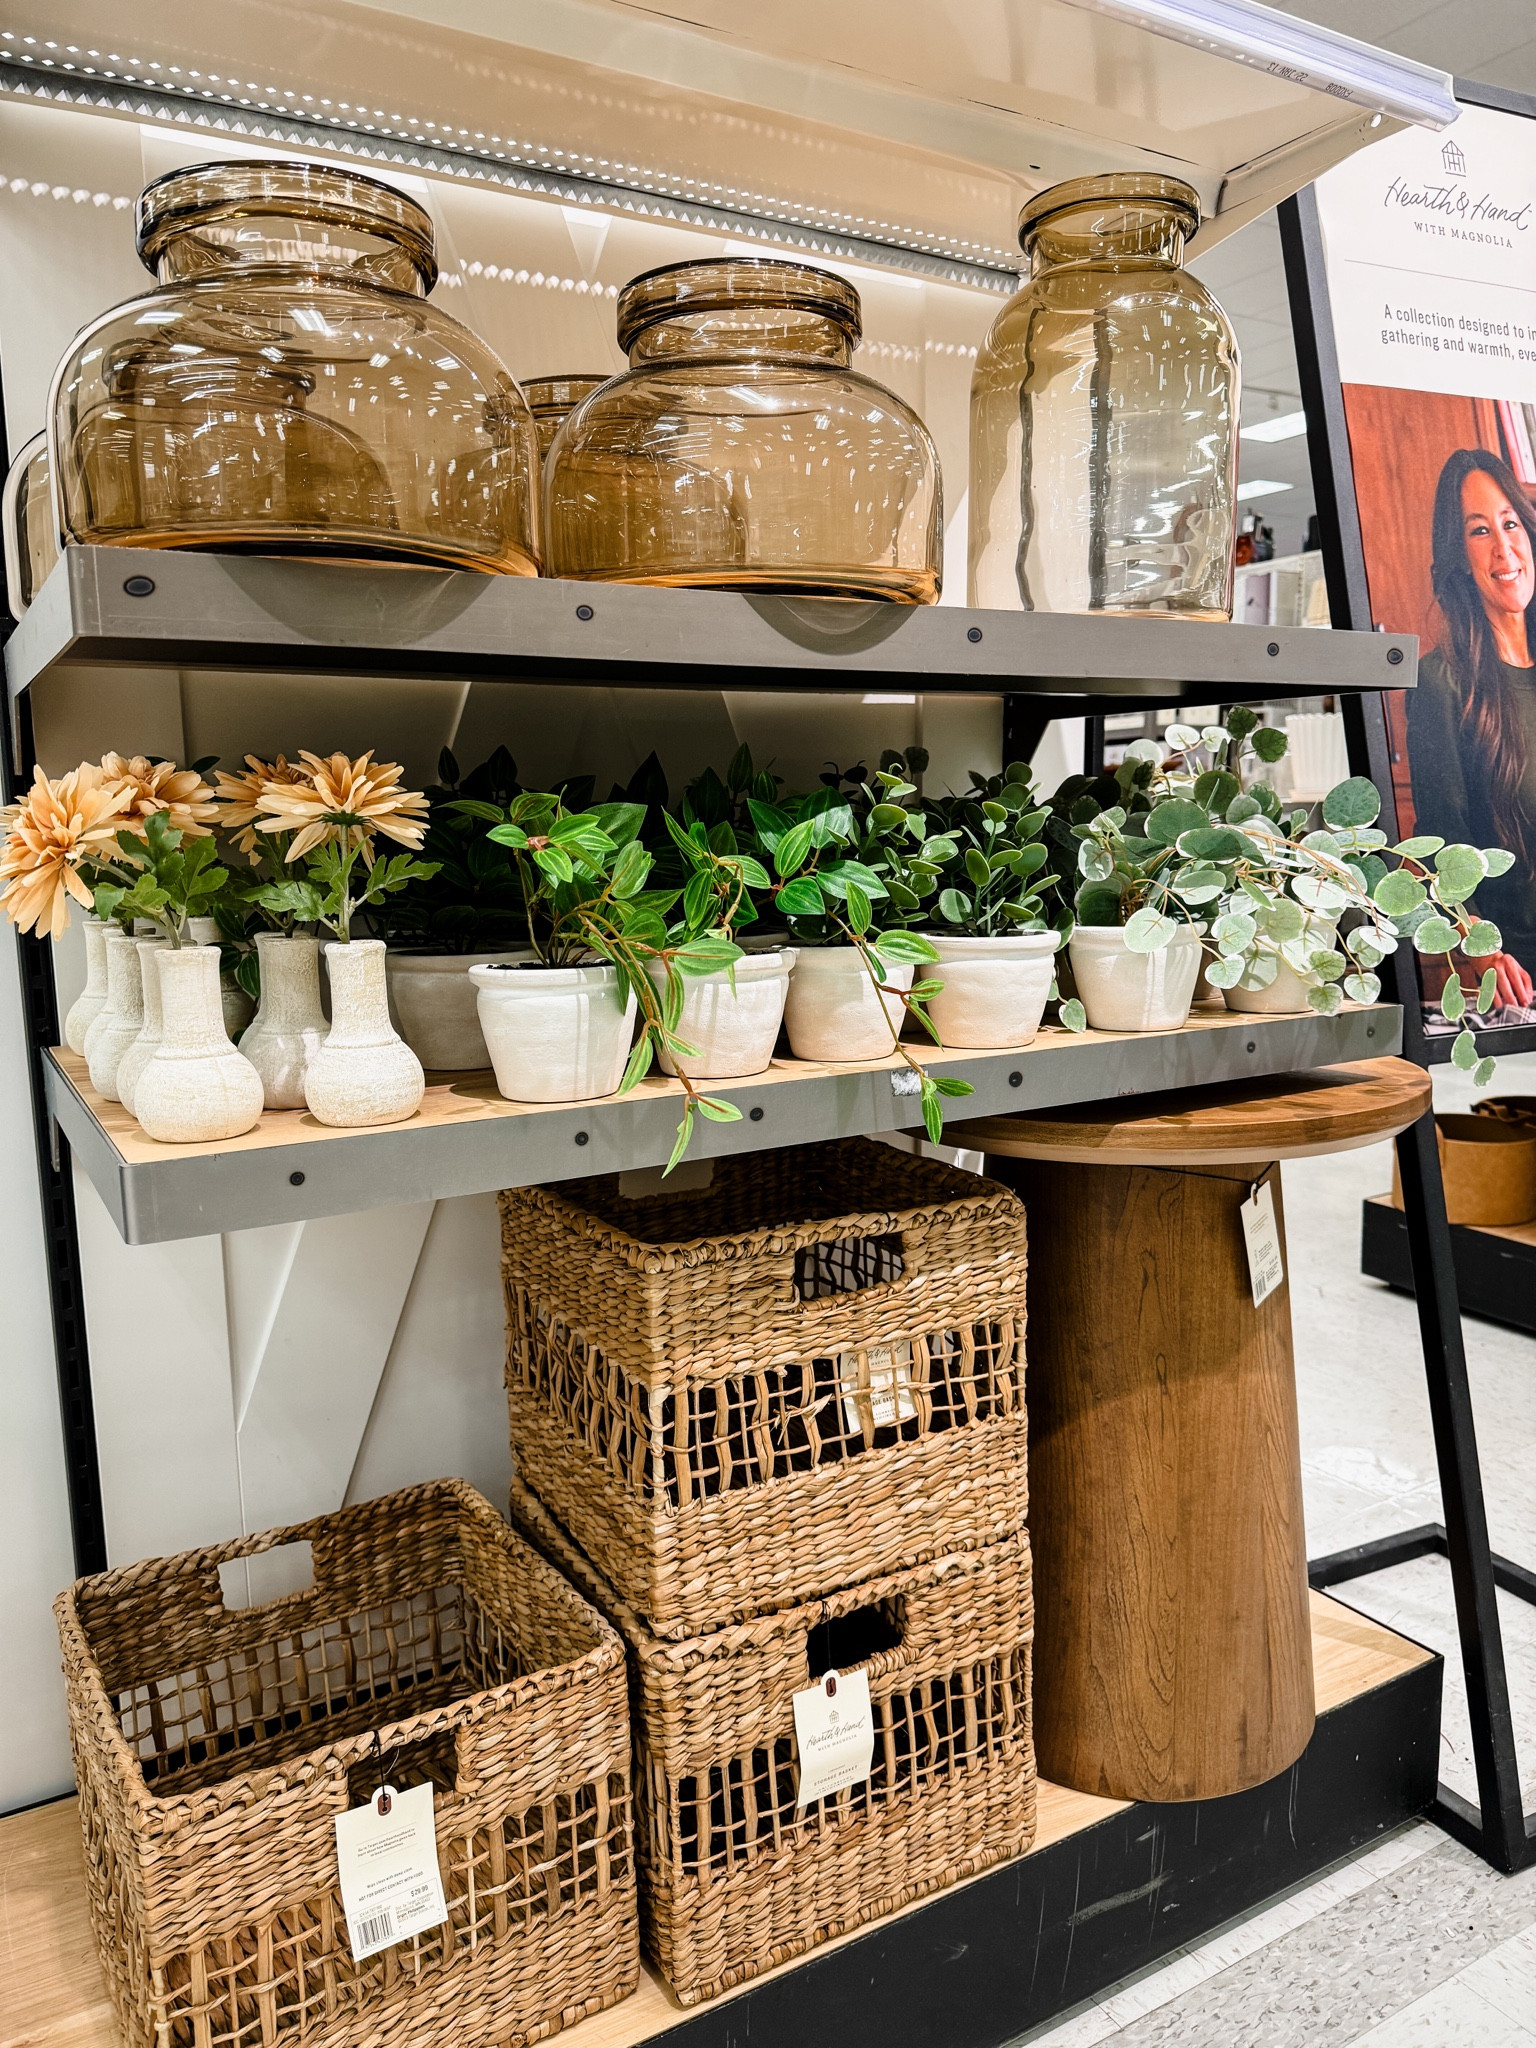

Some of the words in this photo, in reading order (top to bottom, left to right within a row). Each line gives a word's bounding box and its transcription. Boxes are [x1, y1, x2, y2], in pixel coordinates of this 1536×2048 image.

[1384, 176, 1456, 215] Hearth
[1456, 191, 1470, 219] &
[1471, 193, 1531, 231] Hand
[1413, 221, 1446, 236] WITH
[1450, 227, 1513, 249] MAGNOLIA
[1384, 303, 1393, 320] A
[1396, 307, 1455, 329] collection
[1458, 315, 1510, 337] designed
[1513, 325, 1525, 339] to
[1381, 328, 1440, 351] gathering
[1443, 337, 1465, 352] and
[1468, 341, 1515, 361] warmth,
[1518, 348, 1536, 362] eve
[806, 1725, 835, 1750] Hearth
[840, 1715, 866, 1736] Hand
